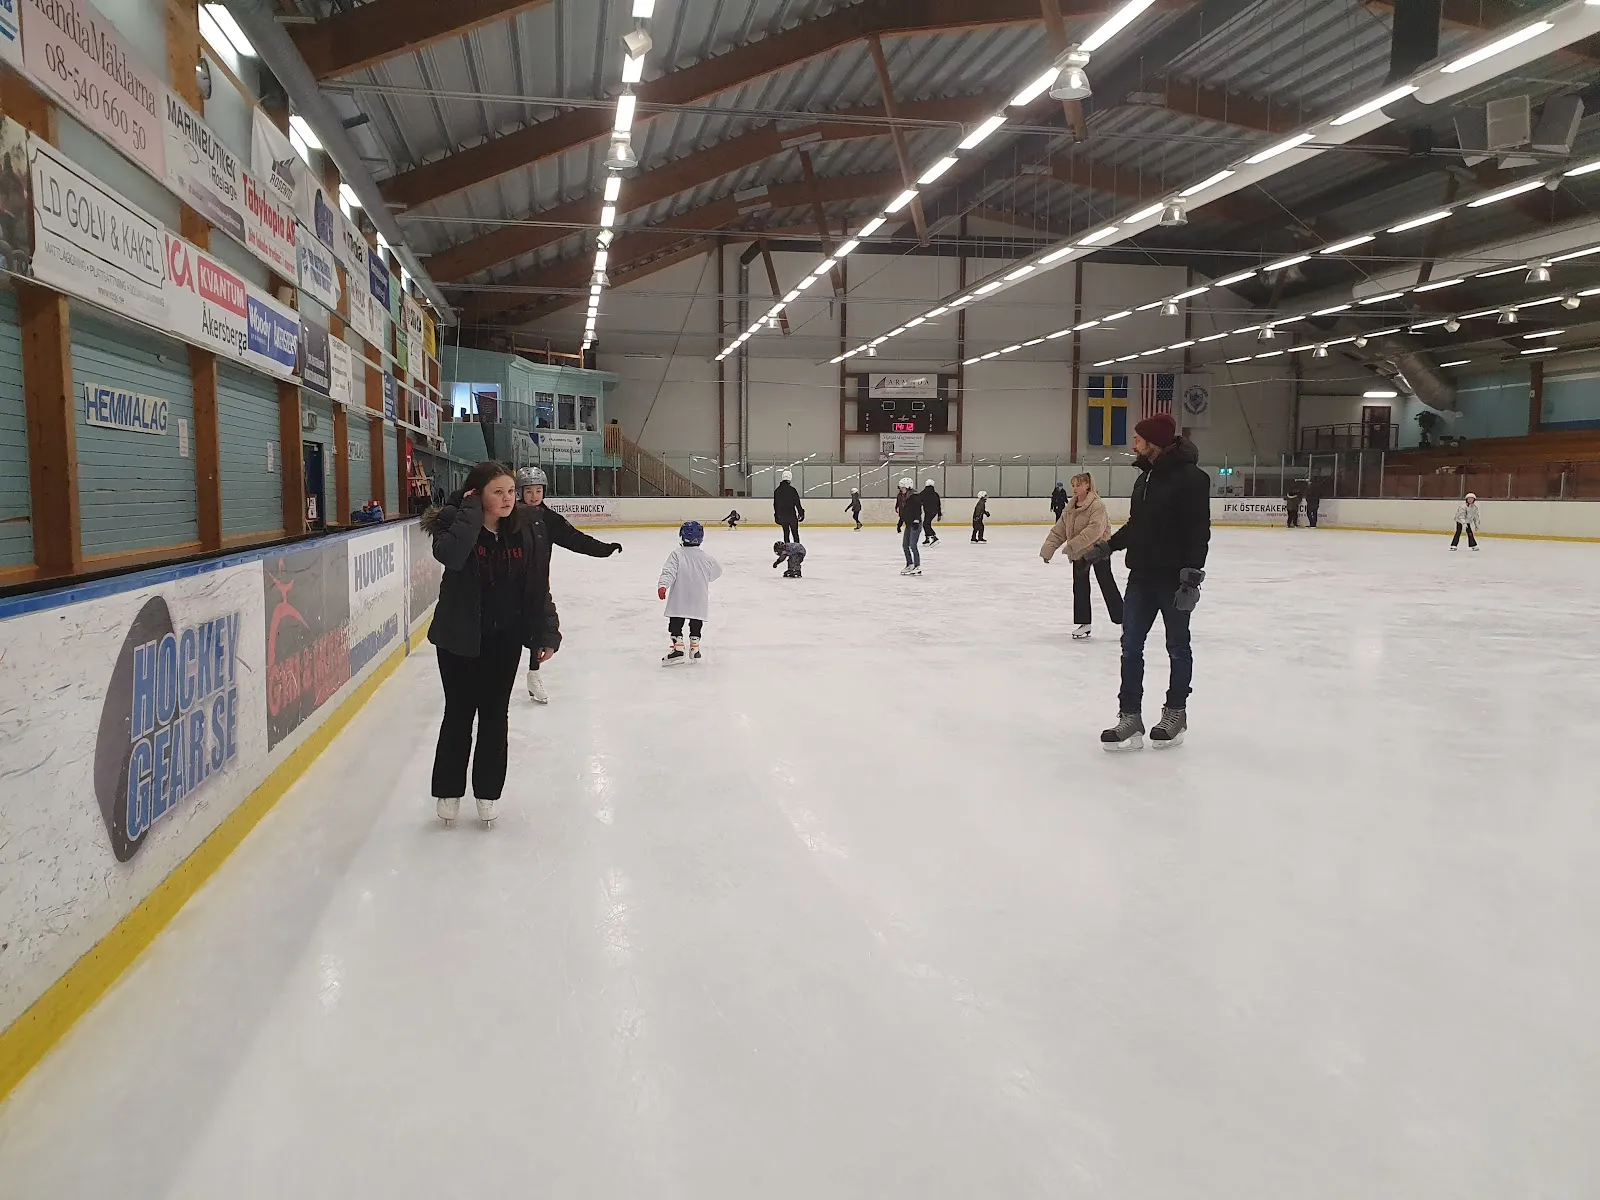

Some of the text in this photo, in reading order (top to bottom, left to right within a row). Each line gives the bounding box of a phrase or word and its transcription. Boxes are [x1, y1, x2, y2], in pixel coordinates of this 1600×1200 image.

[45, 43, 147, 150] 08-540 660 50
[39, 170, 62, 217] LD
[110, 215, 121, 252] &
[122, 221, 160, 274] KAKEL
[164, 234, 195, 293] ICA
[200, 264, 245, 310] KVANTUM
[201, 301, 247, 356] Åkersberga
[86, 386, 168, 430] HEMMALAG
[580, 504, 605, 513] HOCKEY
[1223, 502, 1287, 512] IFK ÖSTERÅKER
[353, 542, 395, 593] HUURRE
[130, 612, 240, 744] HOCKEY
[126, 687, 238, 842] GEAR.SE
